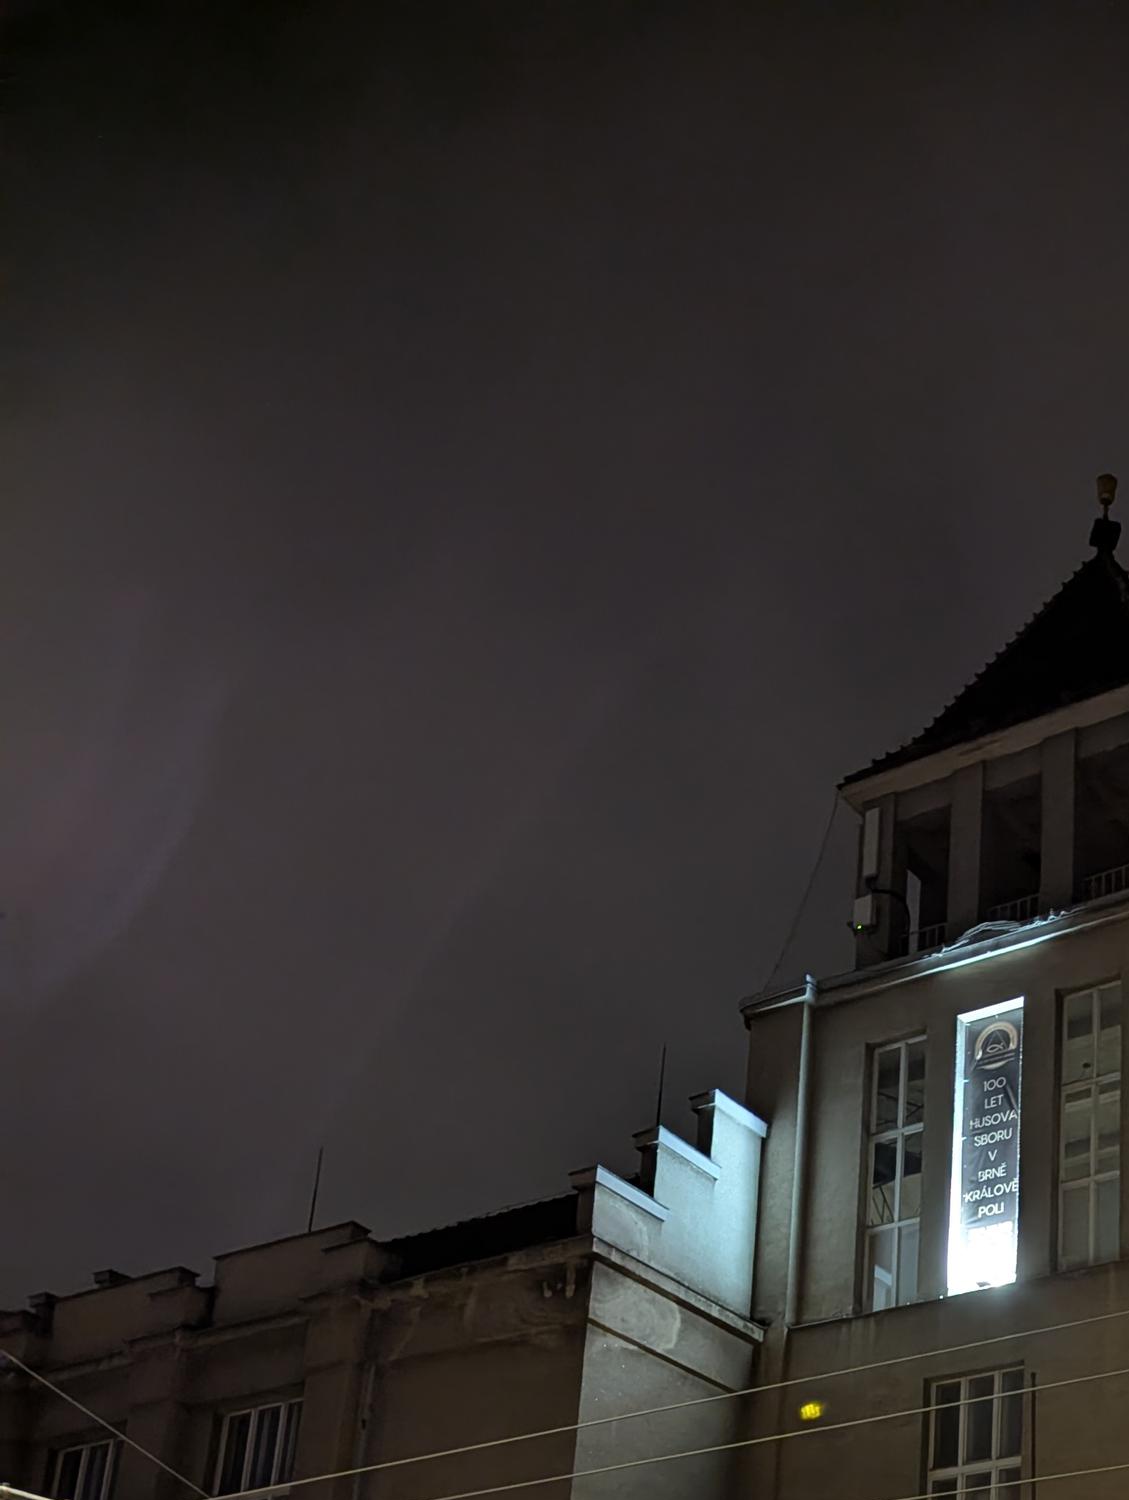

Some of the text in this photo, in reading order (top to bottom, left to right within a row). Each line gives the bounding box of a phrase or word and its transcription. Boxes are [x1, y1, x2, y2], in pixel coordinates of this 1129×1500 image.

[984, 1077, 1006, 1091] 100
[985, 1094, 1003, 1109] LET
[970, 1110, 1017, 1129] HUSOVA
[974, 1128, 1012, 1147] SBORU
[988, 1149, 997, 1161] V
[978, 1162, 1007, 1182] BRNĚ
[978, 1202, 1004, 1218] POLI
